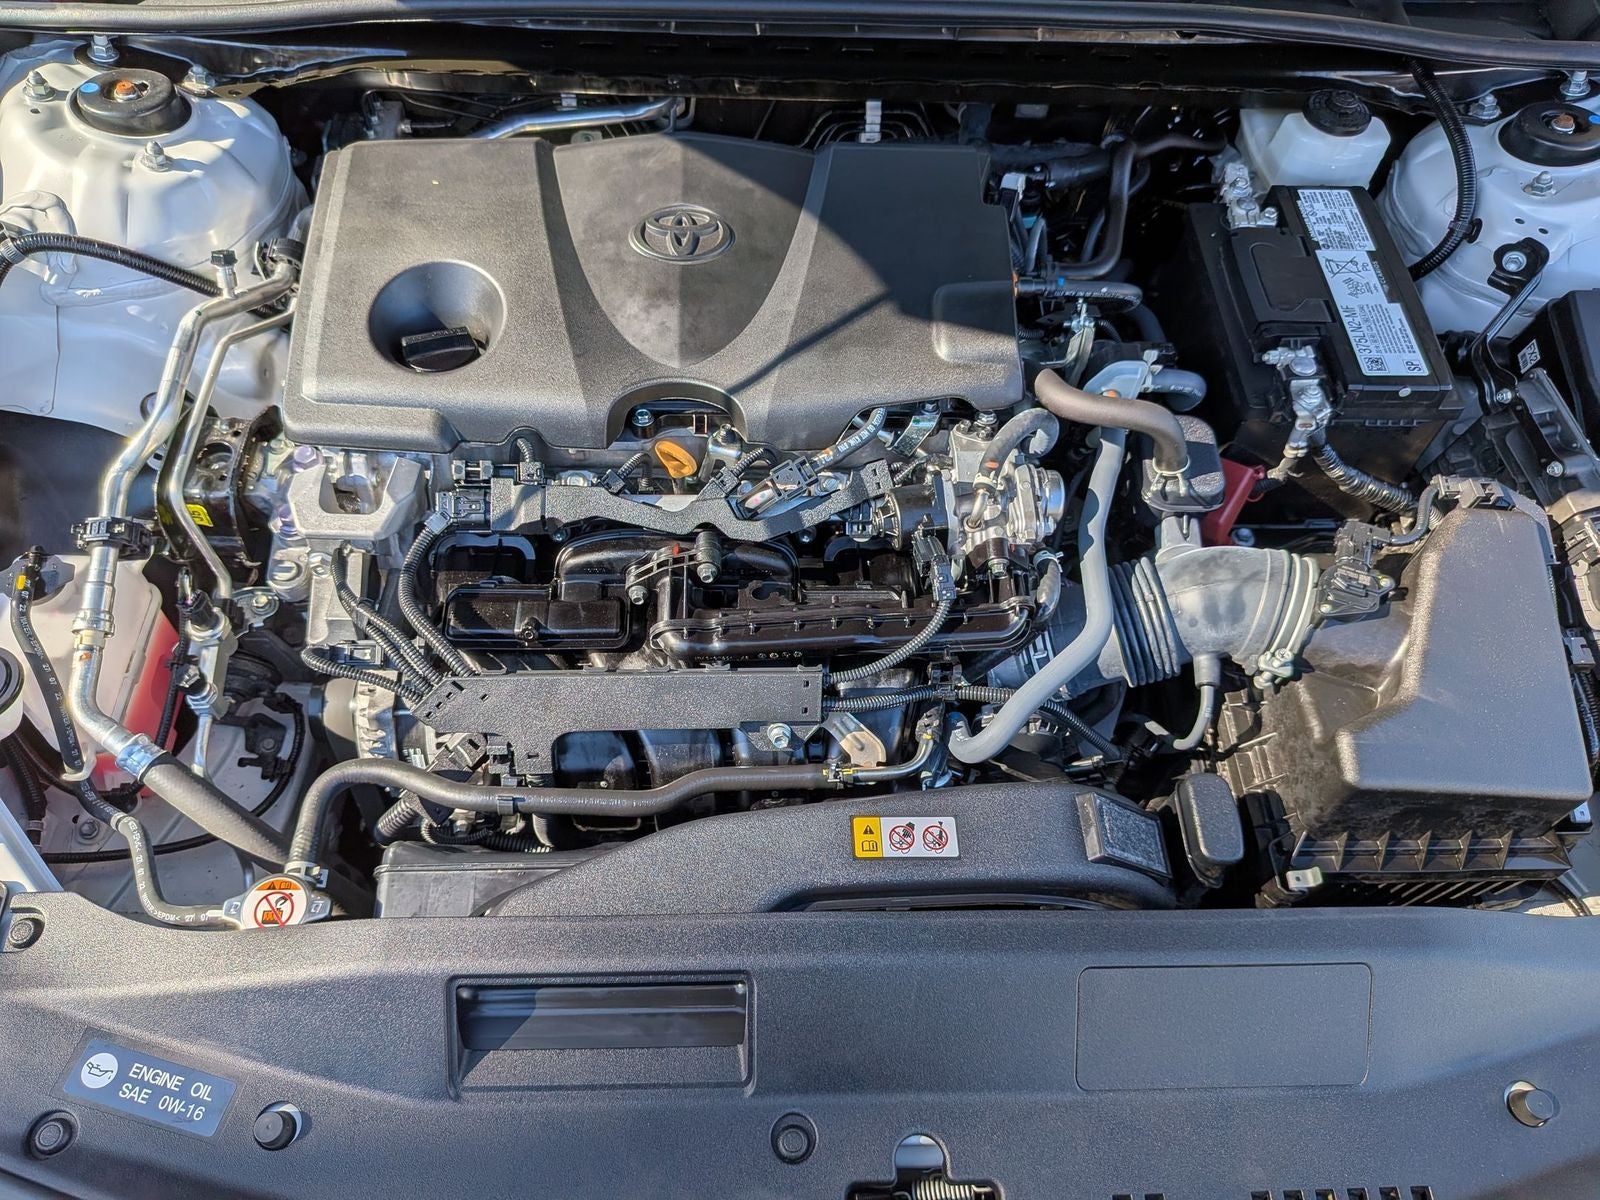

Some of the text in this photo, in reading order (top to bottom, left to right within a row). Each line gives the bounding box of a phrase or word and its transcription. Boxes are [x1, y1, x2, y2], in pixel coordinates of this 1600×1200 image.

[1340, 304, 1372, 354] 375LN2-MF
[1405, 360, 1422, 372] SP
[129, 1063, 212, 1101] ENGINE OIL
[119, 1083, 205, 1120] SAE 0W-16
